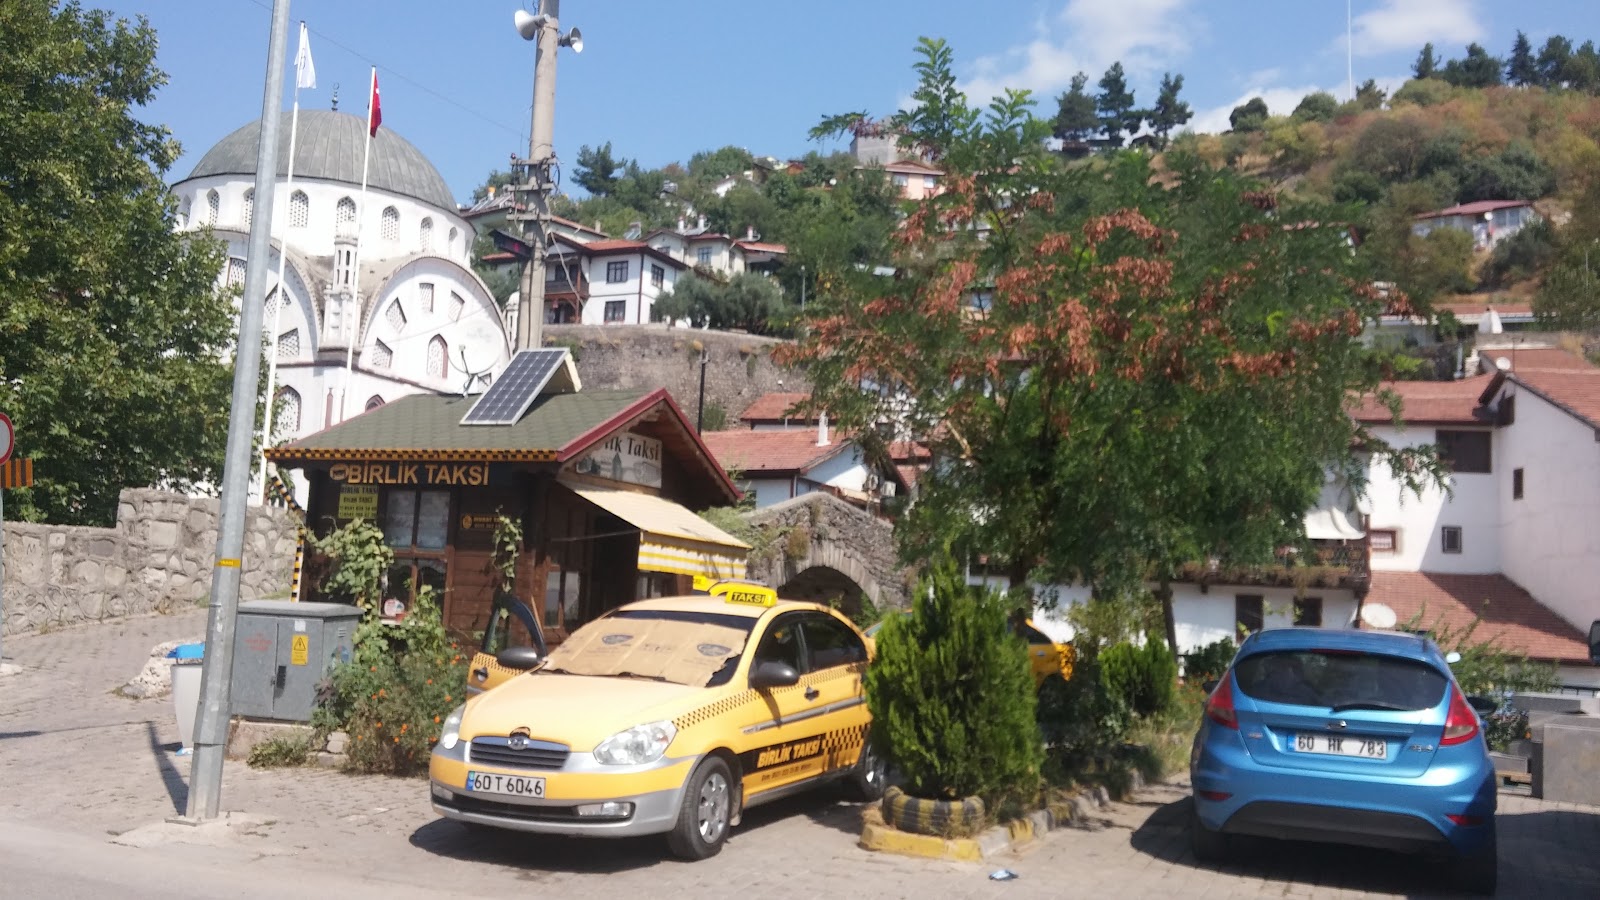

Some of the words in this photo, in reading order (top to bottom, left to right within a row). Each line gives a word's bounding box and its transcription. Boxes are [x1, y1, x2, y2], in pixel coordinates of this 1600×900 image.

[627, 437, 659, 460] Taksi
[348, 461, 418, 484] BİRLİK
[425, 462, 489, 486] TAKSİ
[757, 744, 792, 768] BİRLİK
[793, 736, 821, 760] TAKSİ
[1298, 736, 1314, 751] 60
[1328, 737, 1344, 752] HK
[1359, 740, 1385, 757] 783
[474, 775, 492, 790] 60
[495, 776, 503, 791] T
[506, 778, 543, 795] 6046
